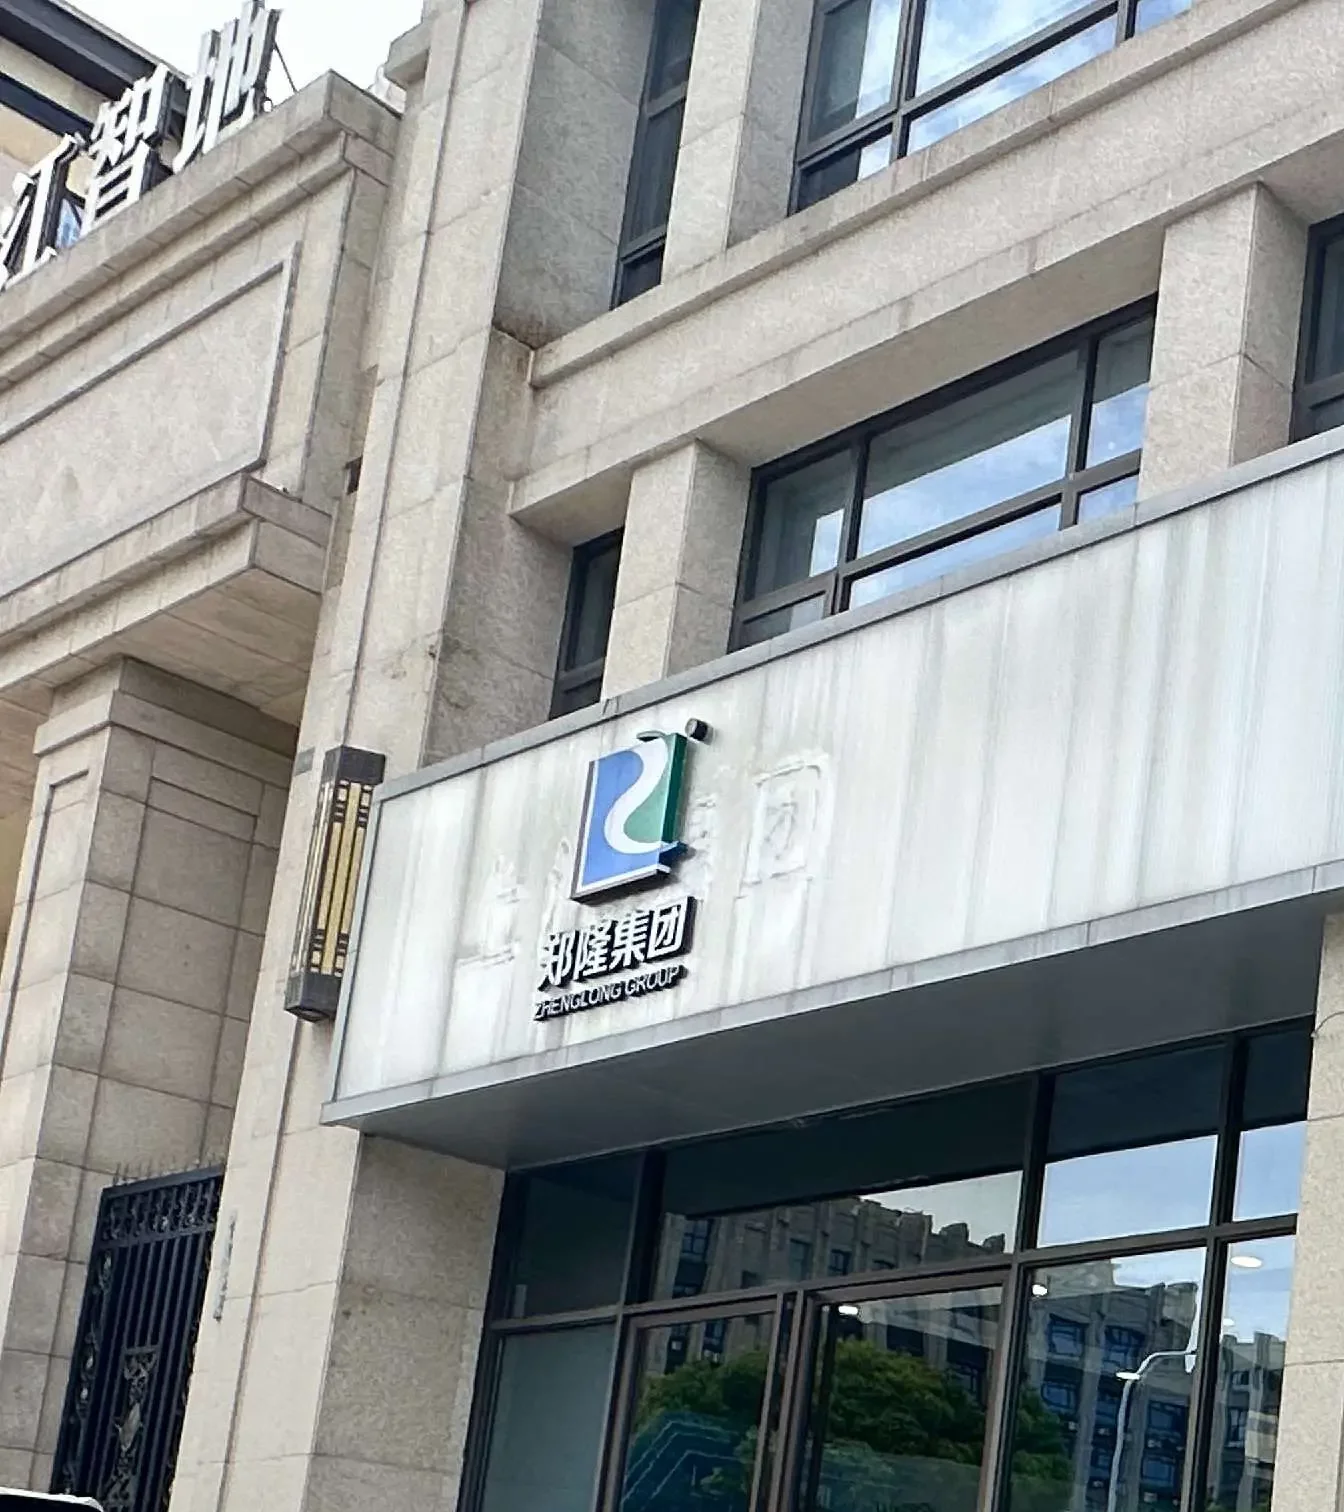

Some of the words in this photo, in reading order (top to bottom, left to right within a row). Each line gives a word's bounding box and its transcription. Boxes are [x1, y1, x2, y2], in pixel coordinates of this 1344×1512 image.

[537, 896, 694, 991] 郑隆集团
[533, 981, 624, 1020] ZHENGLONG
[625, 964, 684, 998] GROUP
